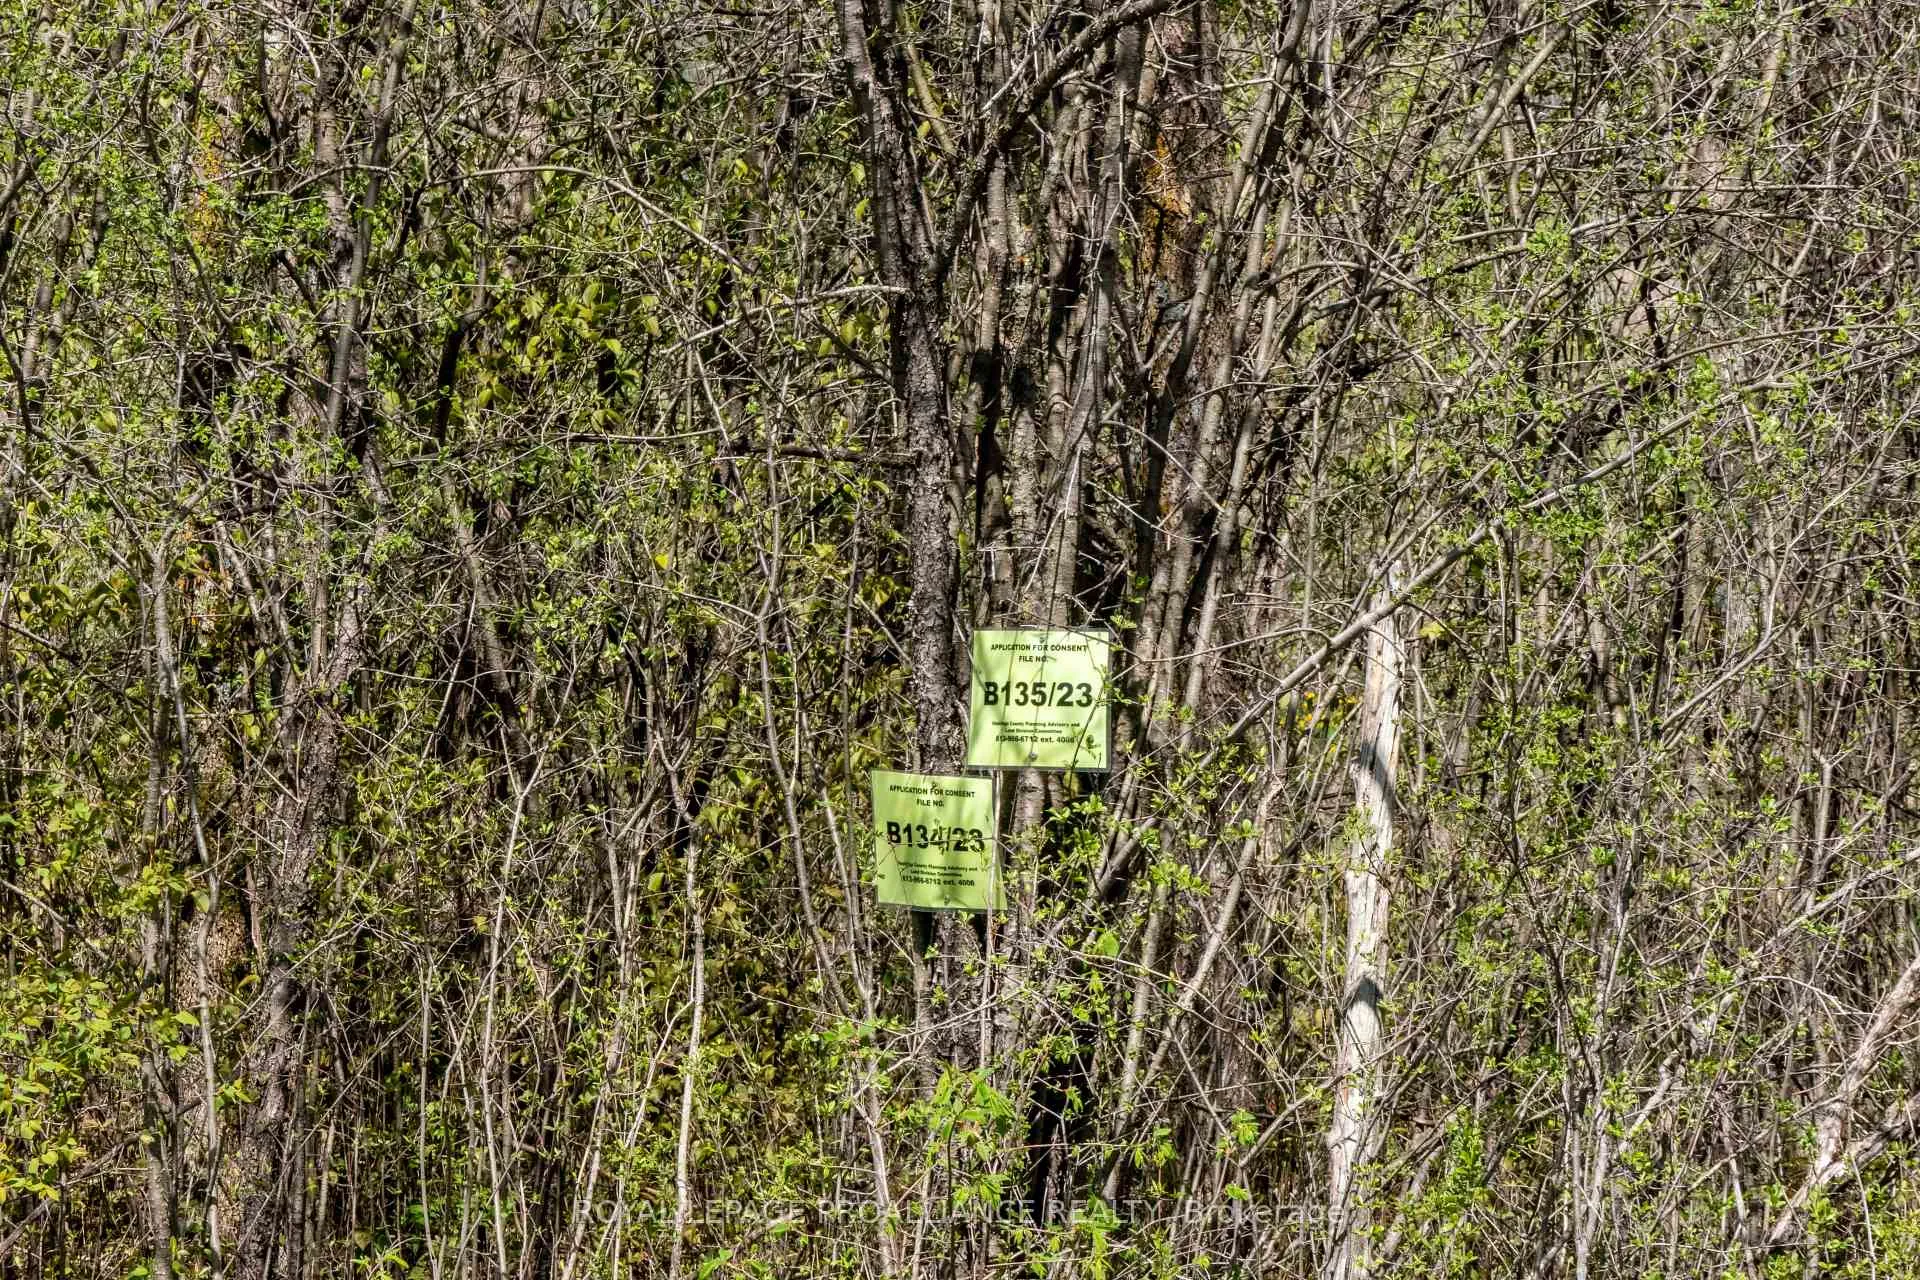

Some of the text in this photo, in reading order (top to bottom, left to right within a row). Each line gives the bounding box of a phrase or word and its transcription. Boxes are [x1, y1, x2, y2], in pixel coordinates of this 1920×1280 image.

[984, 681, 1093, 707] B135/23
[889, 785, 928, 795] APPLICATION
[945, 790, 975, 798] CONSENT
[917, 798, 931, 806] FILE
[887, 821, 985, 852] B134/23
